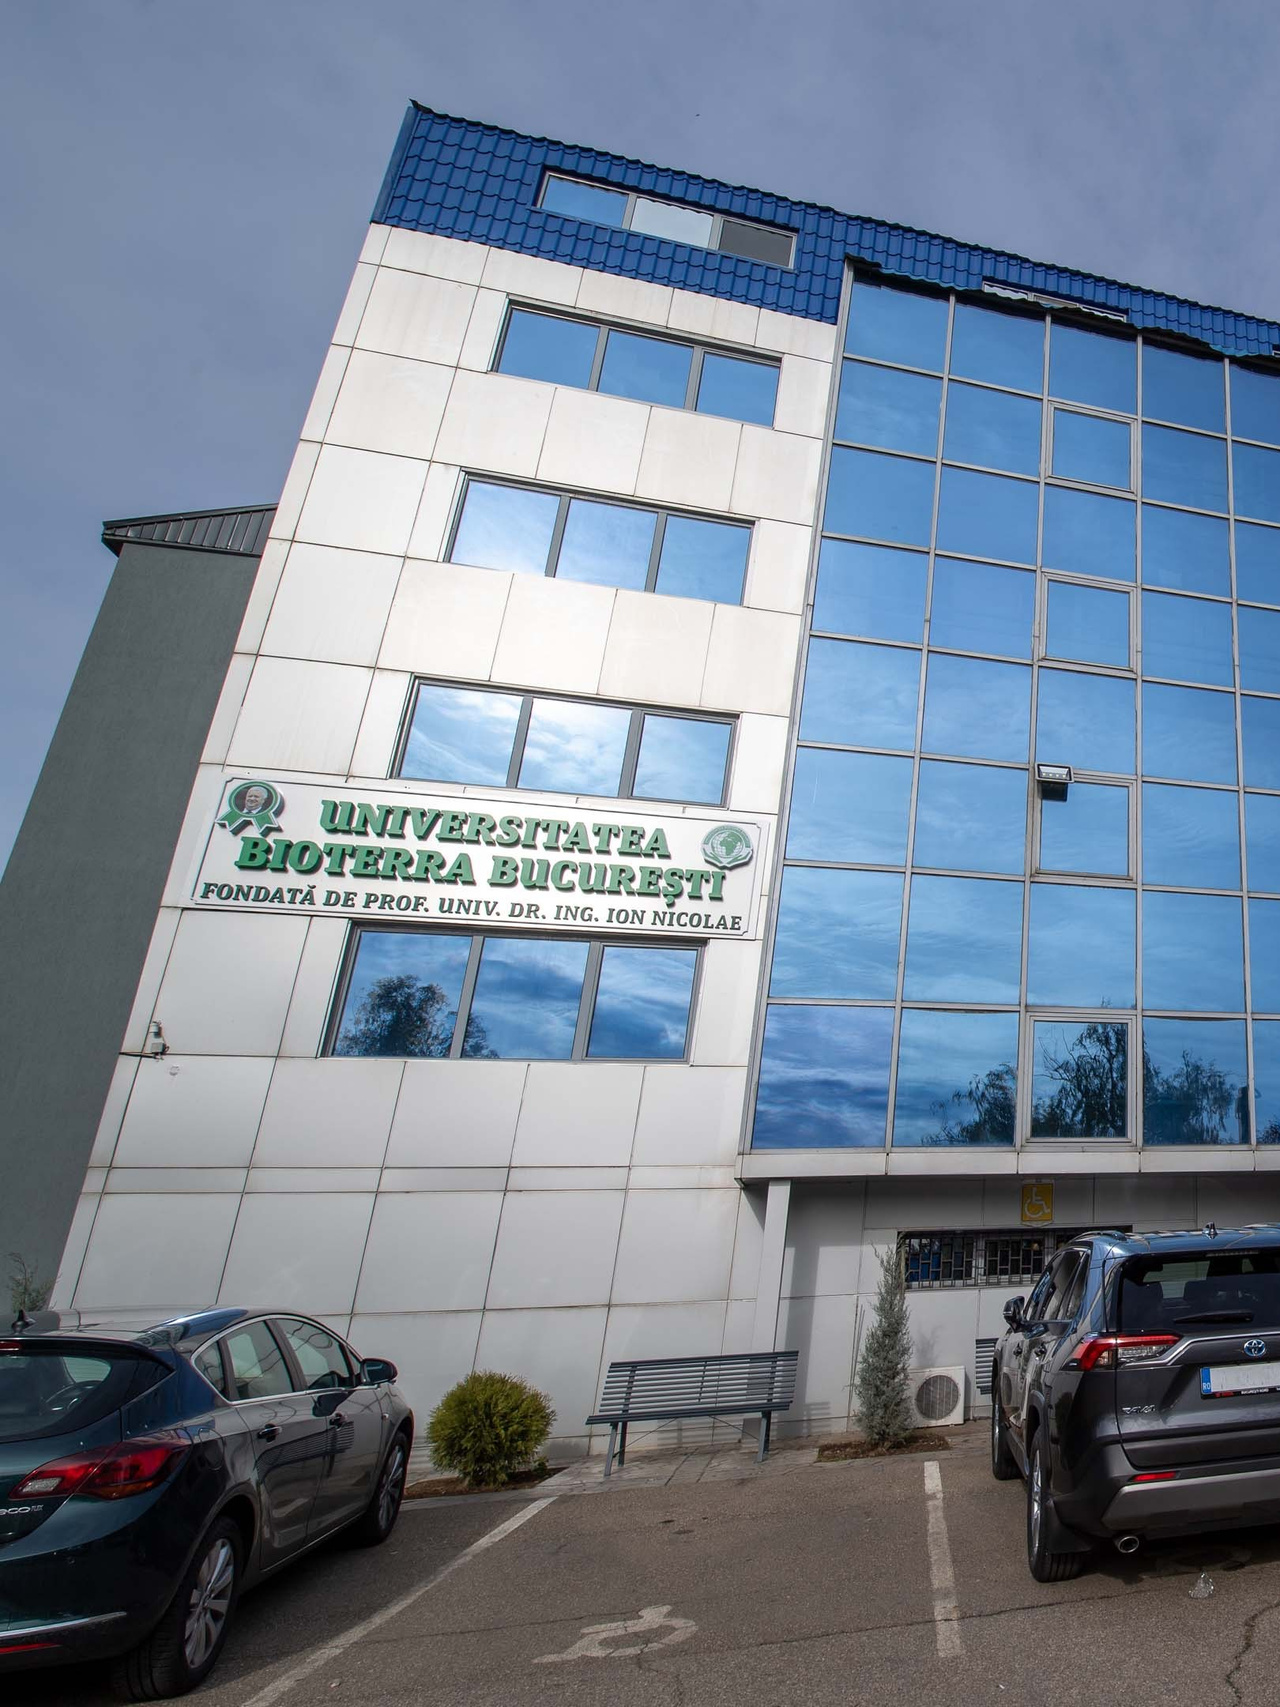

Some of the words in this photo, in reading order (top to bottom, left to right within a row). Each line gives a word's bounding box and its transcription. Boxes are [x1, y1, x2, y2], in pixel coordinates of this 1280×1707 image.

[320, 800, 671, 859] UNIVERSITATEA
[234, 836, 477, 885] BIOTERRA
[487, 855, 727, 908] BUCUREȘTI
[201, 882, 316, 905] FONDATĂ
[322, 890, 358, 908] DE
[362, 892, 430, 912] PROF.
[439, 897, 500, 917] UNIV.
[508, 902, 546, 919] DR.
[554, 905, 599, 922] ING.
[606, 908, 646, 925] ION
[651, 911, 742, 931] NICOLAE
[1202, 1382, 1211, 1390] RO
